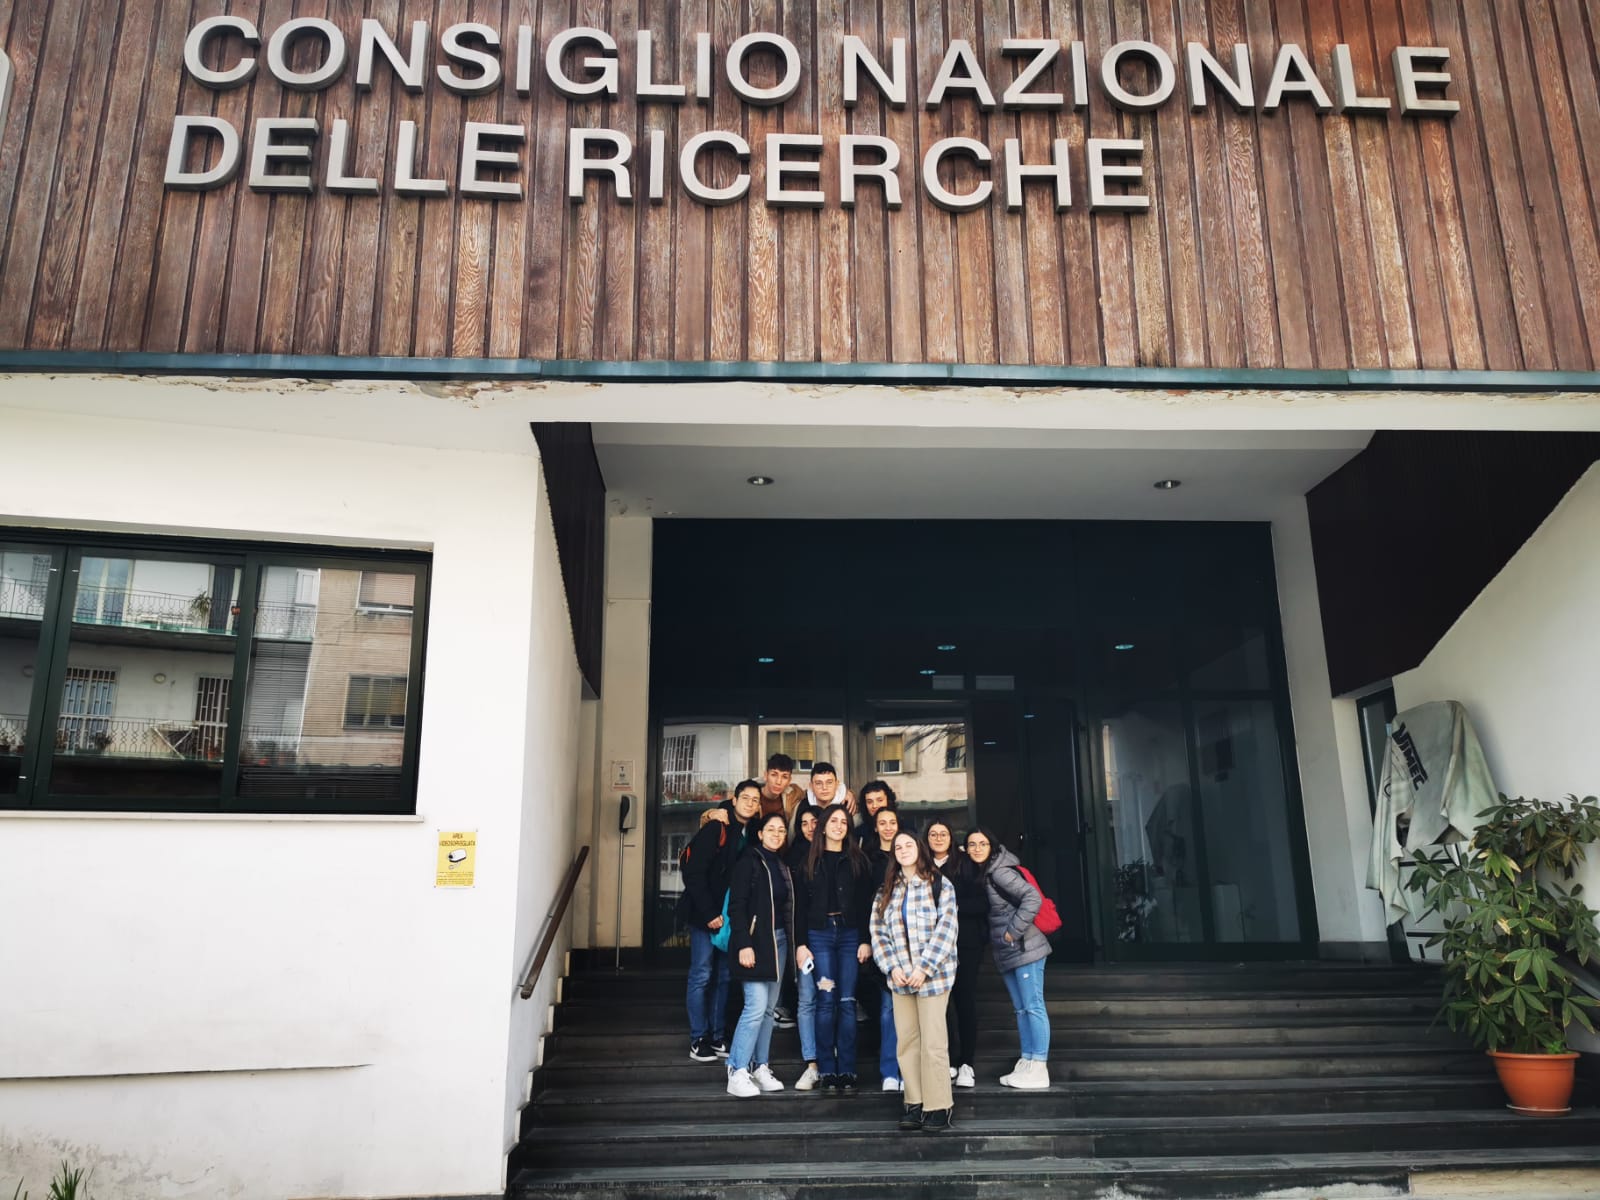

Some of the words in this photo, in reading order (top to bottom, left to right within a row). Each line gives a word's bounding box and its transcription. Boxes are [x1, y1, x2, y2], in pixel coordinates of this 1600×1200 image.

[183, 15, 801, 106] CONSIGLIO
[842, 34, 1461, 118] NAZIONALE
[163, 114, 525, 200] DELLE
[568, 127, 1150, 213] RICERCHE
[1391, 722, 1428, 791] VIMEC
